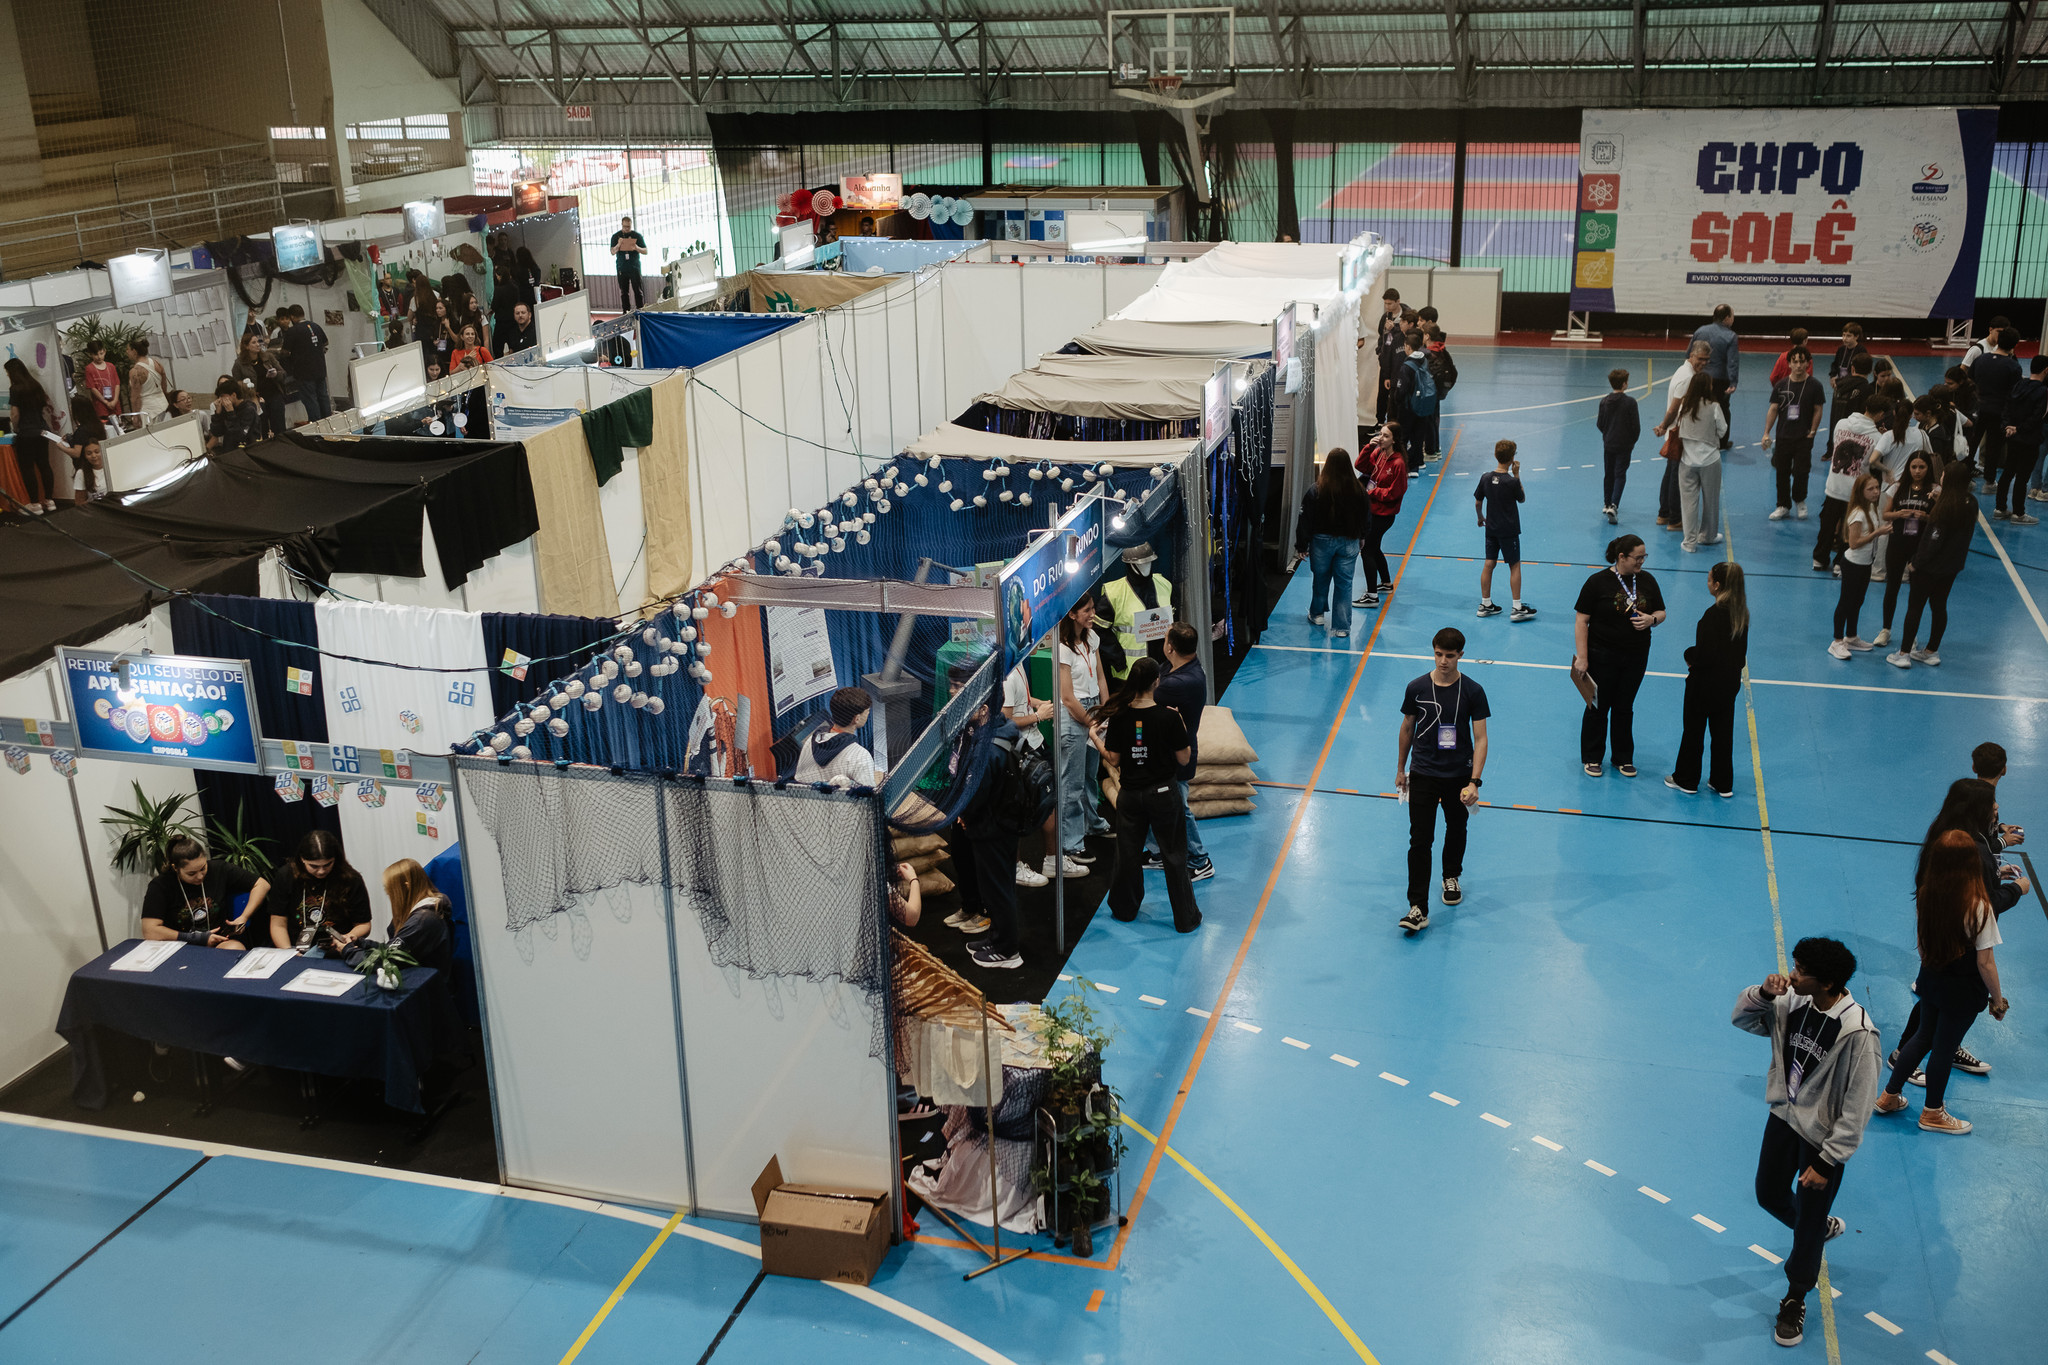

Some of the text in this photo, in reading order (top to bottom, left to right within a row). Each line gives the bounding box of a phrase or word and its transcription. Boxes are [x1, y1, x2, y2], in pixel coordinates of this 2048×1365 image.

[1696, 142, 1864, 195] EXPO
[1690, 198, 1857, 265] SALÊ
[1692, 274, 1719, 282] EVENTO
[1721, 274, 1779, 283] TECNOCIENTÍFICO
[1786, 276, 1821, 284] CULTURAL
[1033, 572, 1046, 598] DO
[1048, 559, 1064, 586] RIO
[1138, 625, 1167, 634] ENCONTRA
[67, 658, 243, 684] RETIRE QUI SEU SELO DE
[88, 675, 228, 702] APRSENTAÇÃO!
[775, 1228, 789, 1237] brf
